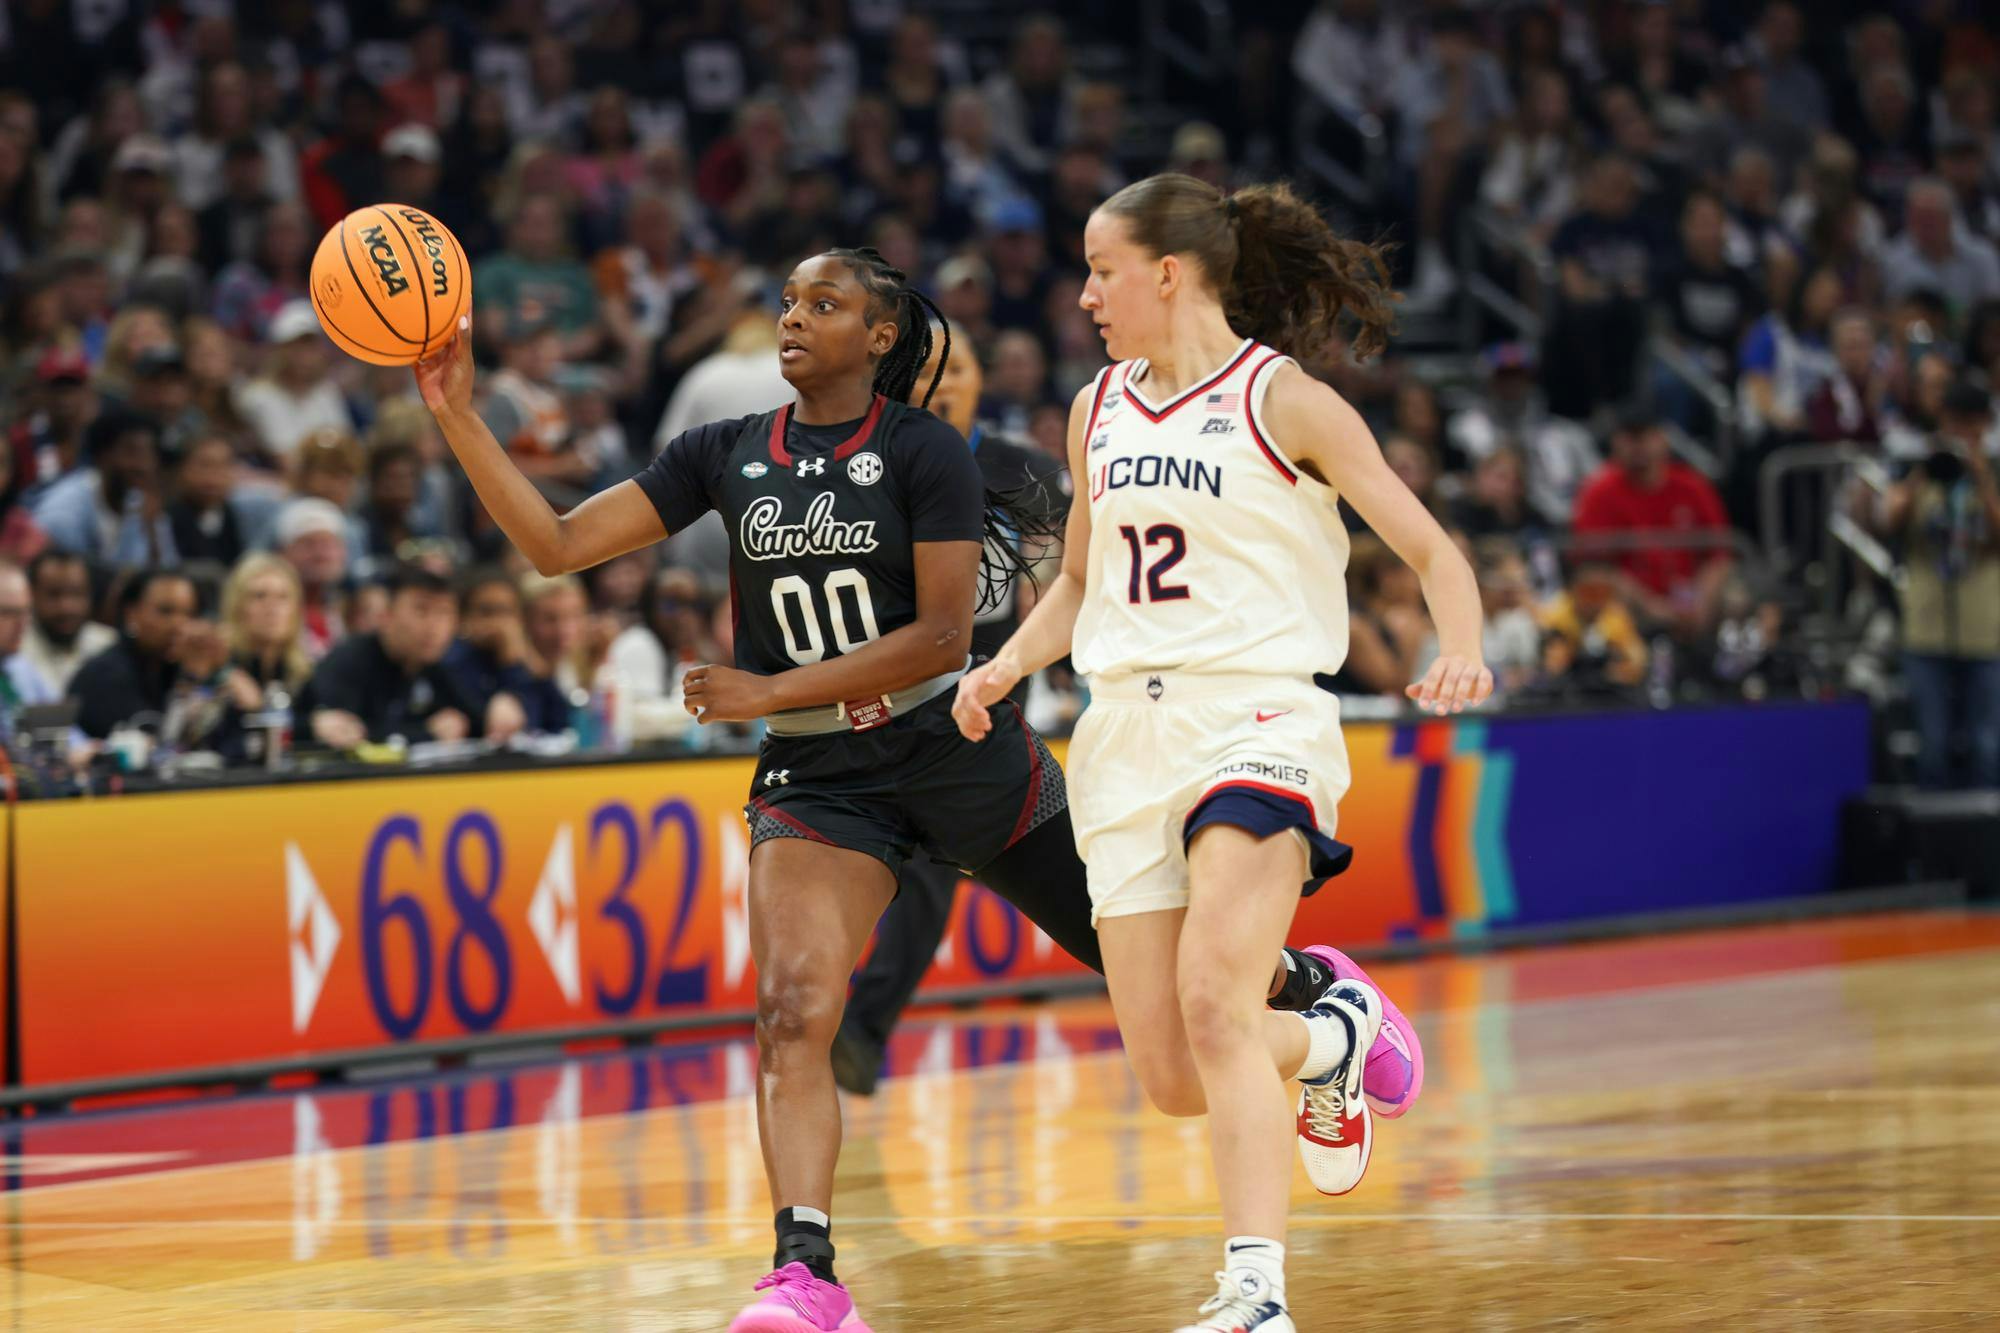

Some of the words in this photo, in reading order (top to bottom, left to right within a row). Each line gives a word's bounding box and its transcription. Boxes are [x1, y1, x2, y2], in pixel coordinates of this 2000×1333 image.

[359, 224, 410, 298] NCAA
[399, 208, 449, 297] Wilson
[1200, 424, 1237, 433] EAST
[850, 455, 881, 482] SEC
[1092, 455, 1222, 503] UCONN
[740, 491, 880, 561] Carolina
[1118, 523, 1191, 604] 12
[770, 568, 881, 666] 00
[851, 702, 882, 717] CAROLINA
[858, 710, 880, 723] SOUTH
[357, 806, 514, 1042] 68
[588, 796, 714, 1016] 32
